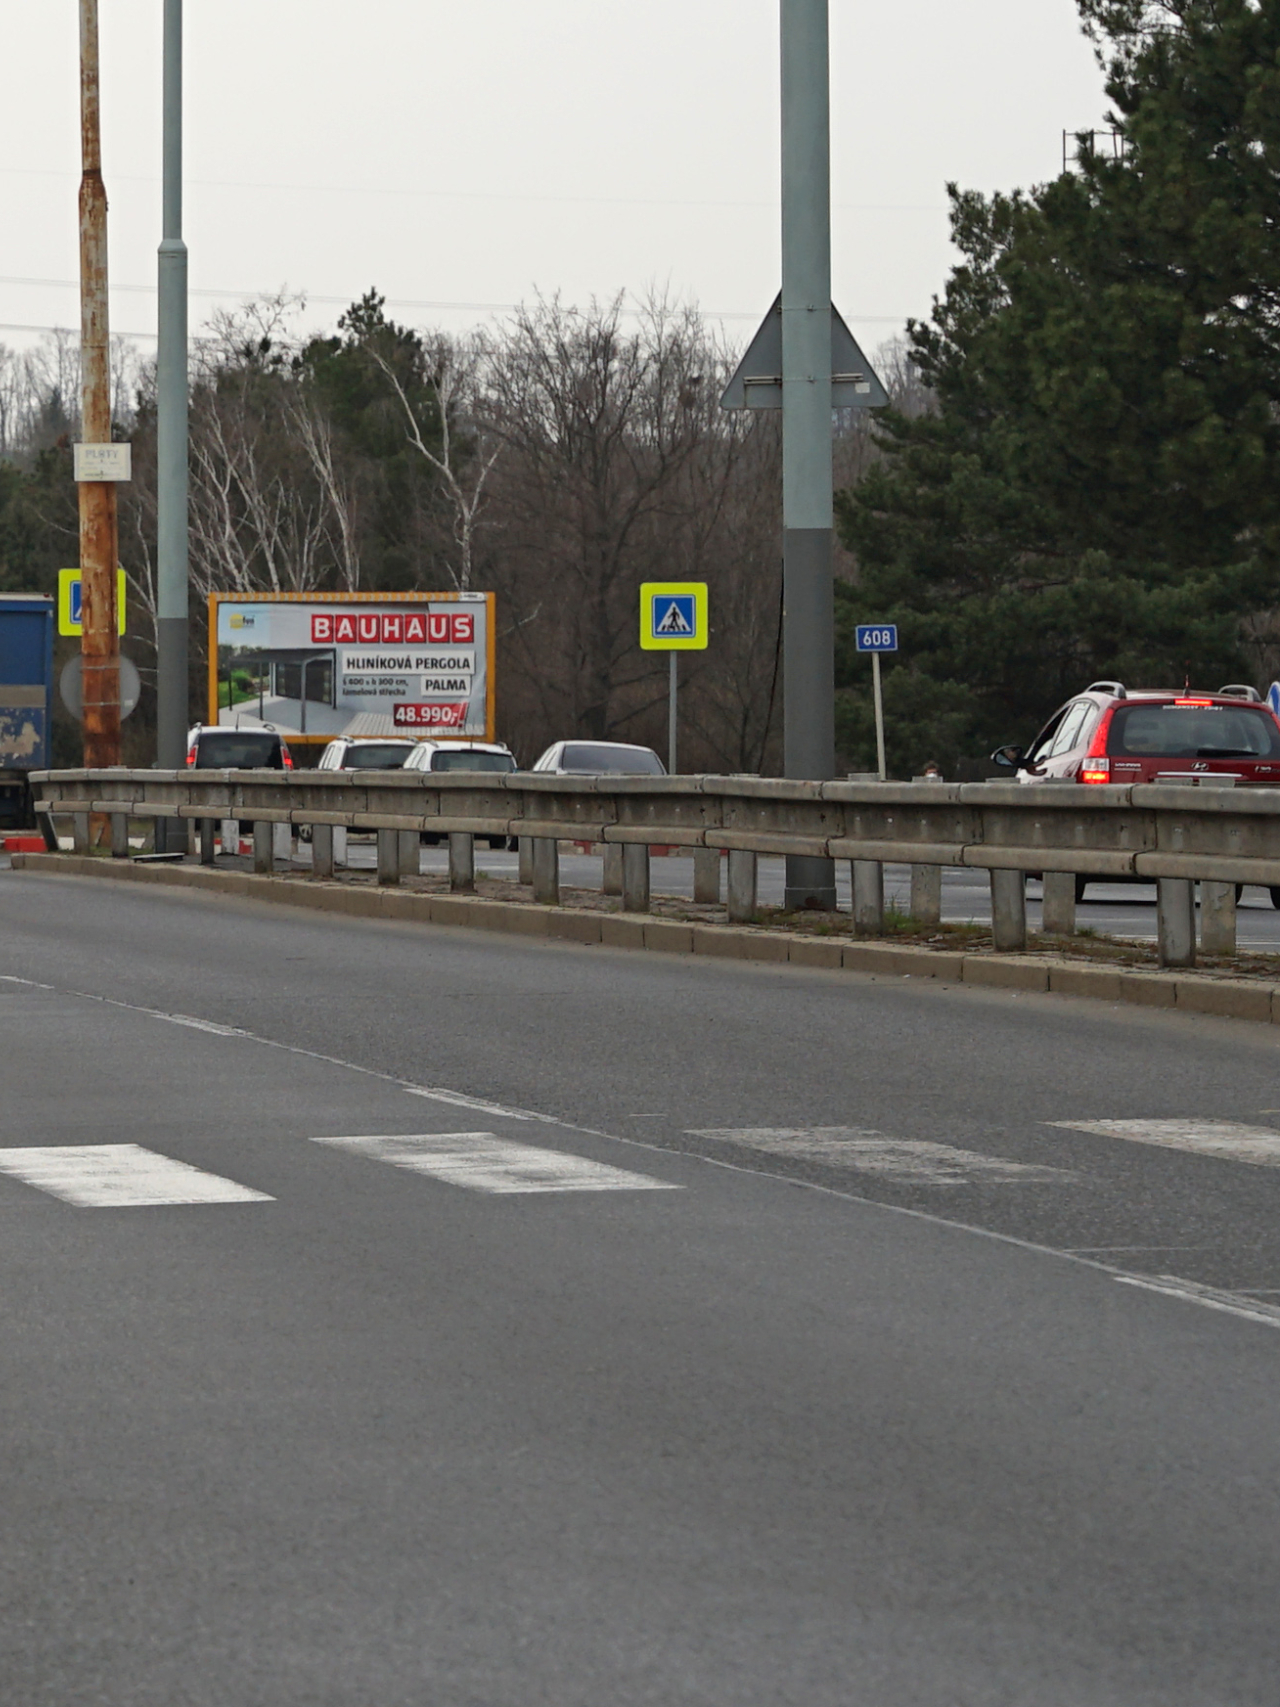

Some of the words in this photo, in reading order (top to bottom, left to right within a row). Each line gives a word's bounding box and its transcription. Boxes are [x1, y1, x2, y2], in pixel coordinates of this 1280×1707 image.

[313, 616, 472, 640] BAUHAUS
[863, 630, 891, 646] 608
[346, 656, 413, 670] HLINÍKOVÁ
[415, 657, 471, 670] PERGOLA
[425, 679, 467, 692] PALMA
